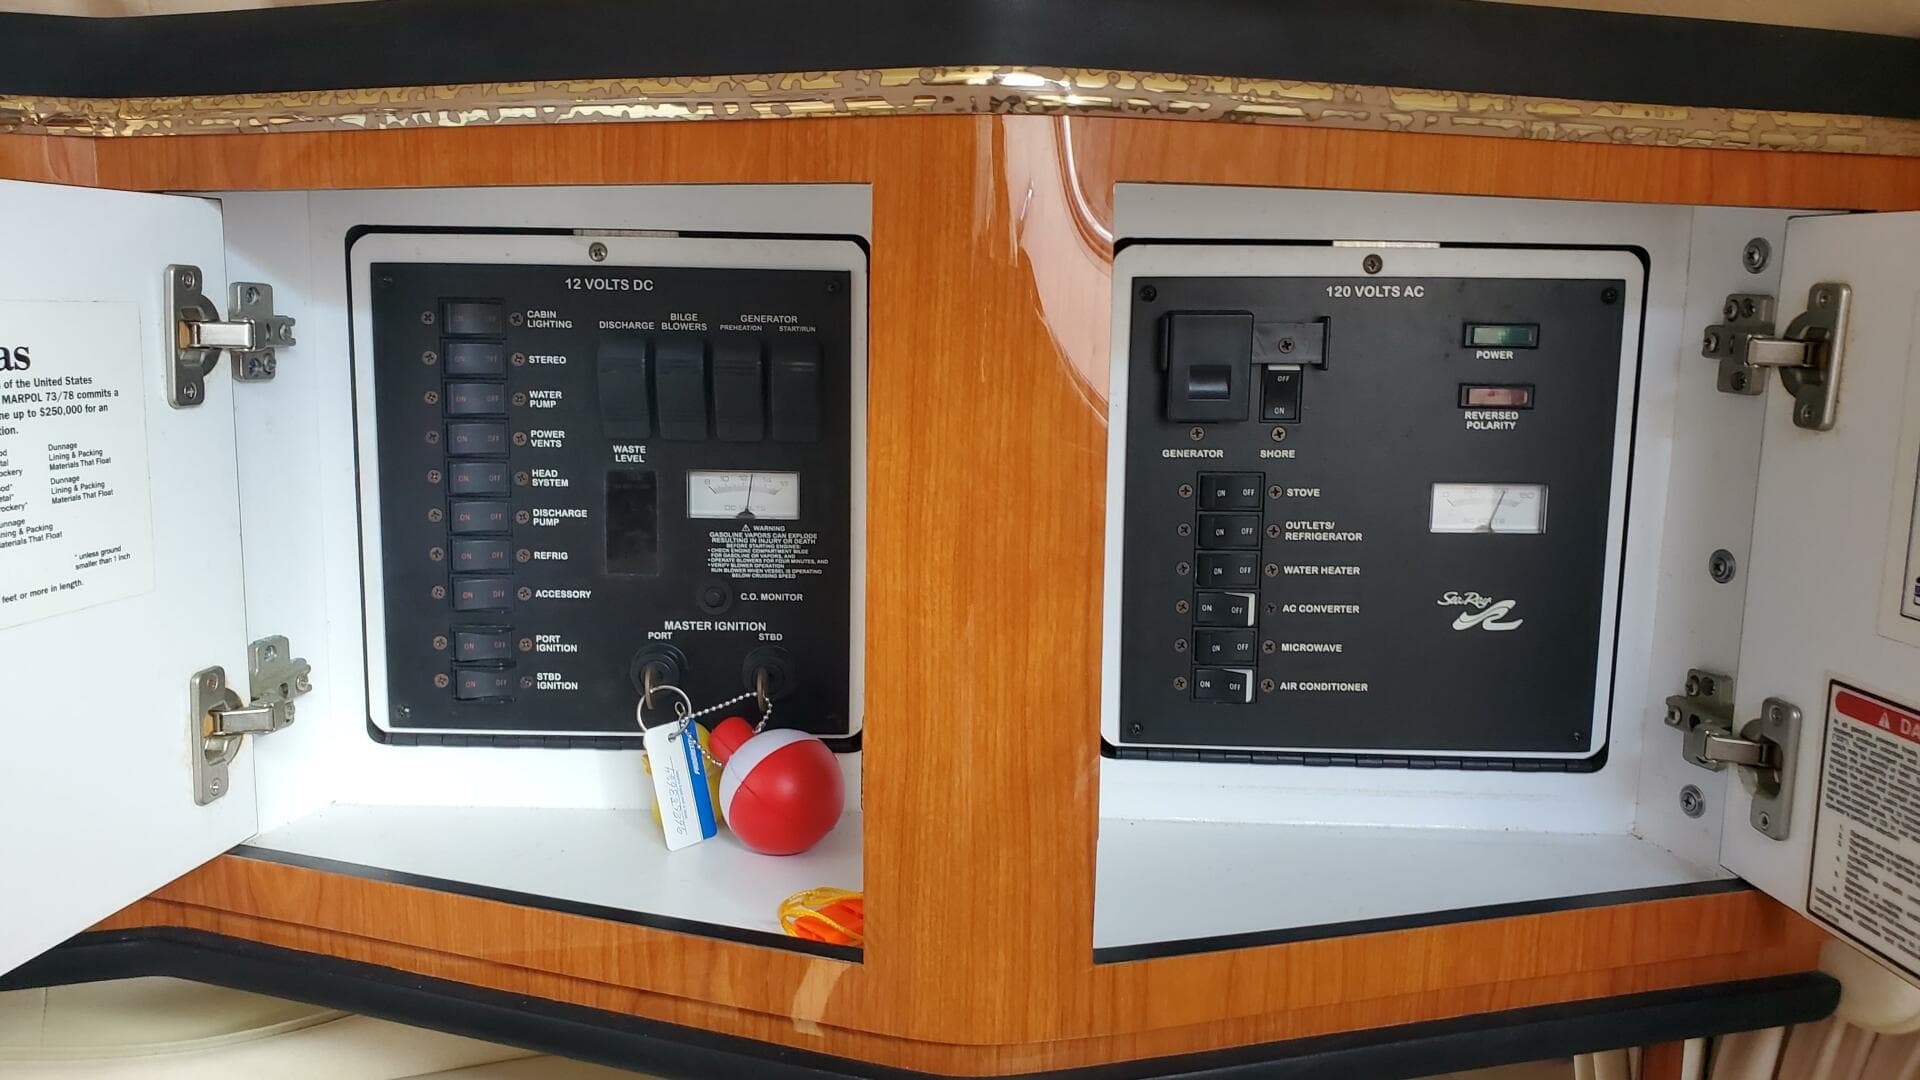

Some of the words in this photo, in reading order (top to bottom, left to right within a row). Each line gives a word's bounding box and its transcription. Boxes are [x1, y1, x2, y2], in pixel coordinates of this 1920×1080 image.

[565, 279, 582, 290] 12
[585, 279, 630, 290] VOLTS
[634, 280, 654, 291] DC
[1326, 286, 1350, 298] 120
[1355, 286, 1400, 298] VOLTS
[1404, 286, 1424, 298] AC
[527, 310, 557, 318] CABIN
[670, 313, 698, 322] BILGE
[740, 314, 798, 324] GENERATOR
[527, 320, 572, 329] LIGHTING
[599, 322, 654, 330] DISCHARGE
[661, 322, 708, 332] BLOWERS
[1476, 350, 1514, 359] POWER
[528, 356, 566, 364] STEREO
[4, 379, 12, 388] of
[16, 379, 30, 388] the
[34, 377, 62, 388] United
[65, 376, 92, 386] States
[2, 393, 42, 404] MARPOL
[45, 391, 74, 402] 73/78
[77, 389, 112, 399] commits
[529, 390, 562, 399] WATER
[530, 400, 556, 408] PUMP
[13, 410, 24, 420] up
[27, 410, 36, 418] to
[40, 404, 82, 416] $250,000
[85, 404, 96, 413] for
[1464, 412, 1519, 420] REVERSED
[1466, 422, 1516, 430] POLARITY
[530, 430, 566, 438] POWER
[48, 443, 78, 451] Dunnage
[530, 440, 562, 448] VENTS
[613, 446, 646, 454] WASTE
[1162, 450, 1224, 458] GENERATOR
[1260, 450, 1296, 458] SHORE
[49, 453, 70, 461] Lining
[78, 450, 104, 458] Packing
[616, 454, 644, 462] LEVEL
[50, 462, 80, 470] Materials
[532, 470, 558, 478] HEAD
[50, 476, 80, 484] Dunnage
[532, 478, 568, 487] SYSTEM
[80, 482, 105, 490] Packing
[1286, 488, 1320, 497] STOVE
[52, 494, 82, 504] Materials
[532, 509, 588, 518] DISCHARGE
[533, 518, 560, 526] PUMP
[1286, 522, 1334, 530] OUTLETS/
[26, 524, 54, 534] Packing
[28, 534, 44, 543] That
[46, 532, 62, 540] Float
[1285, 532, 1362, 541] REFRIGERATOR
[79, 551, 100, 560] unless
[100, 546, 122, 557] ground
[534, 552, 568, 560] REFRIG
[76, 560, 98, 570] smaller
[99, 556, 112, 566] than
[119, 552, 130, 560] inch
[1284, 566, 1318, 574] WATER
[1320, 566, 1360, 575] HEATER
[20, 591, 28, 600] or
[30, 588, 48, 598] more
[51, 584, 58, 592] in
[536, 590, 592, 598] ACCESSORY
[740, 592, 758, 600] C.O.
[760, 593, 804, 601] MONITOR
[1282, 604, 1296, 613] AC
[1299, 604, 1360, 614] CONVERTER
[664, 621, 712, 630] MASTER
[714, 622, 766, 631] IGNITION
[536, 635, 561, 643] PORT
[758, 632, 782, 641] STBD
[536, 644, 578, 652] IGNITION
[1282, 644, 1342, 652] MICROWAVE
[537, 673, 562, 681] STBD
[537, 682, 578, 690] IGNITION
[1280, 682, 1298, 690] AIR
[1300, 682, 1368, 692] CONDITIONER
